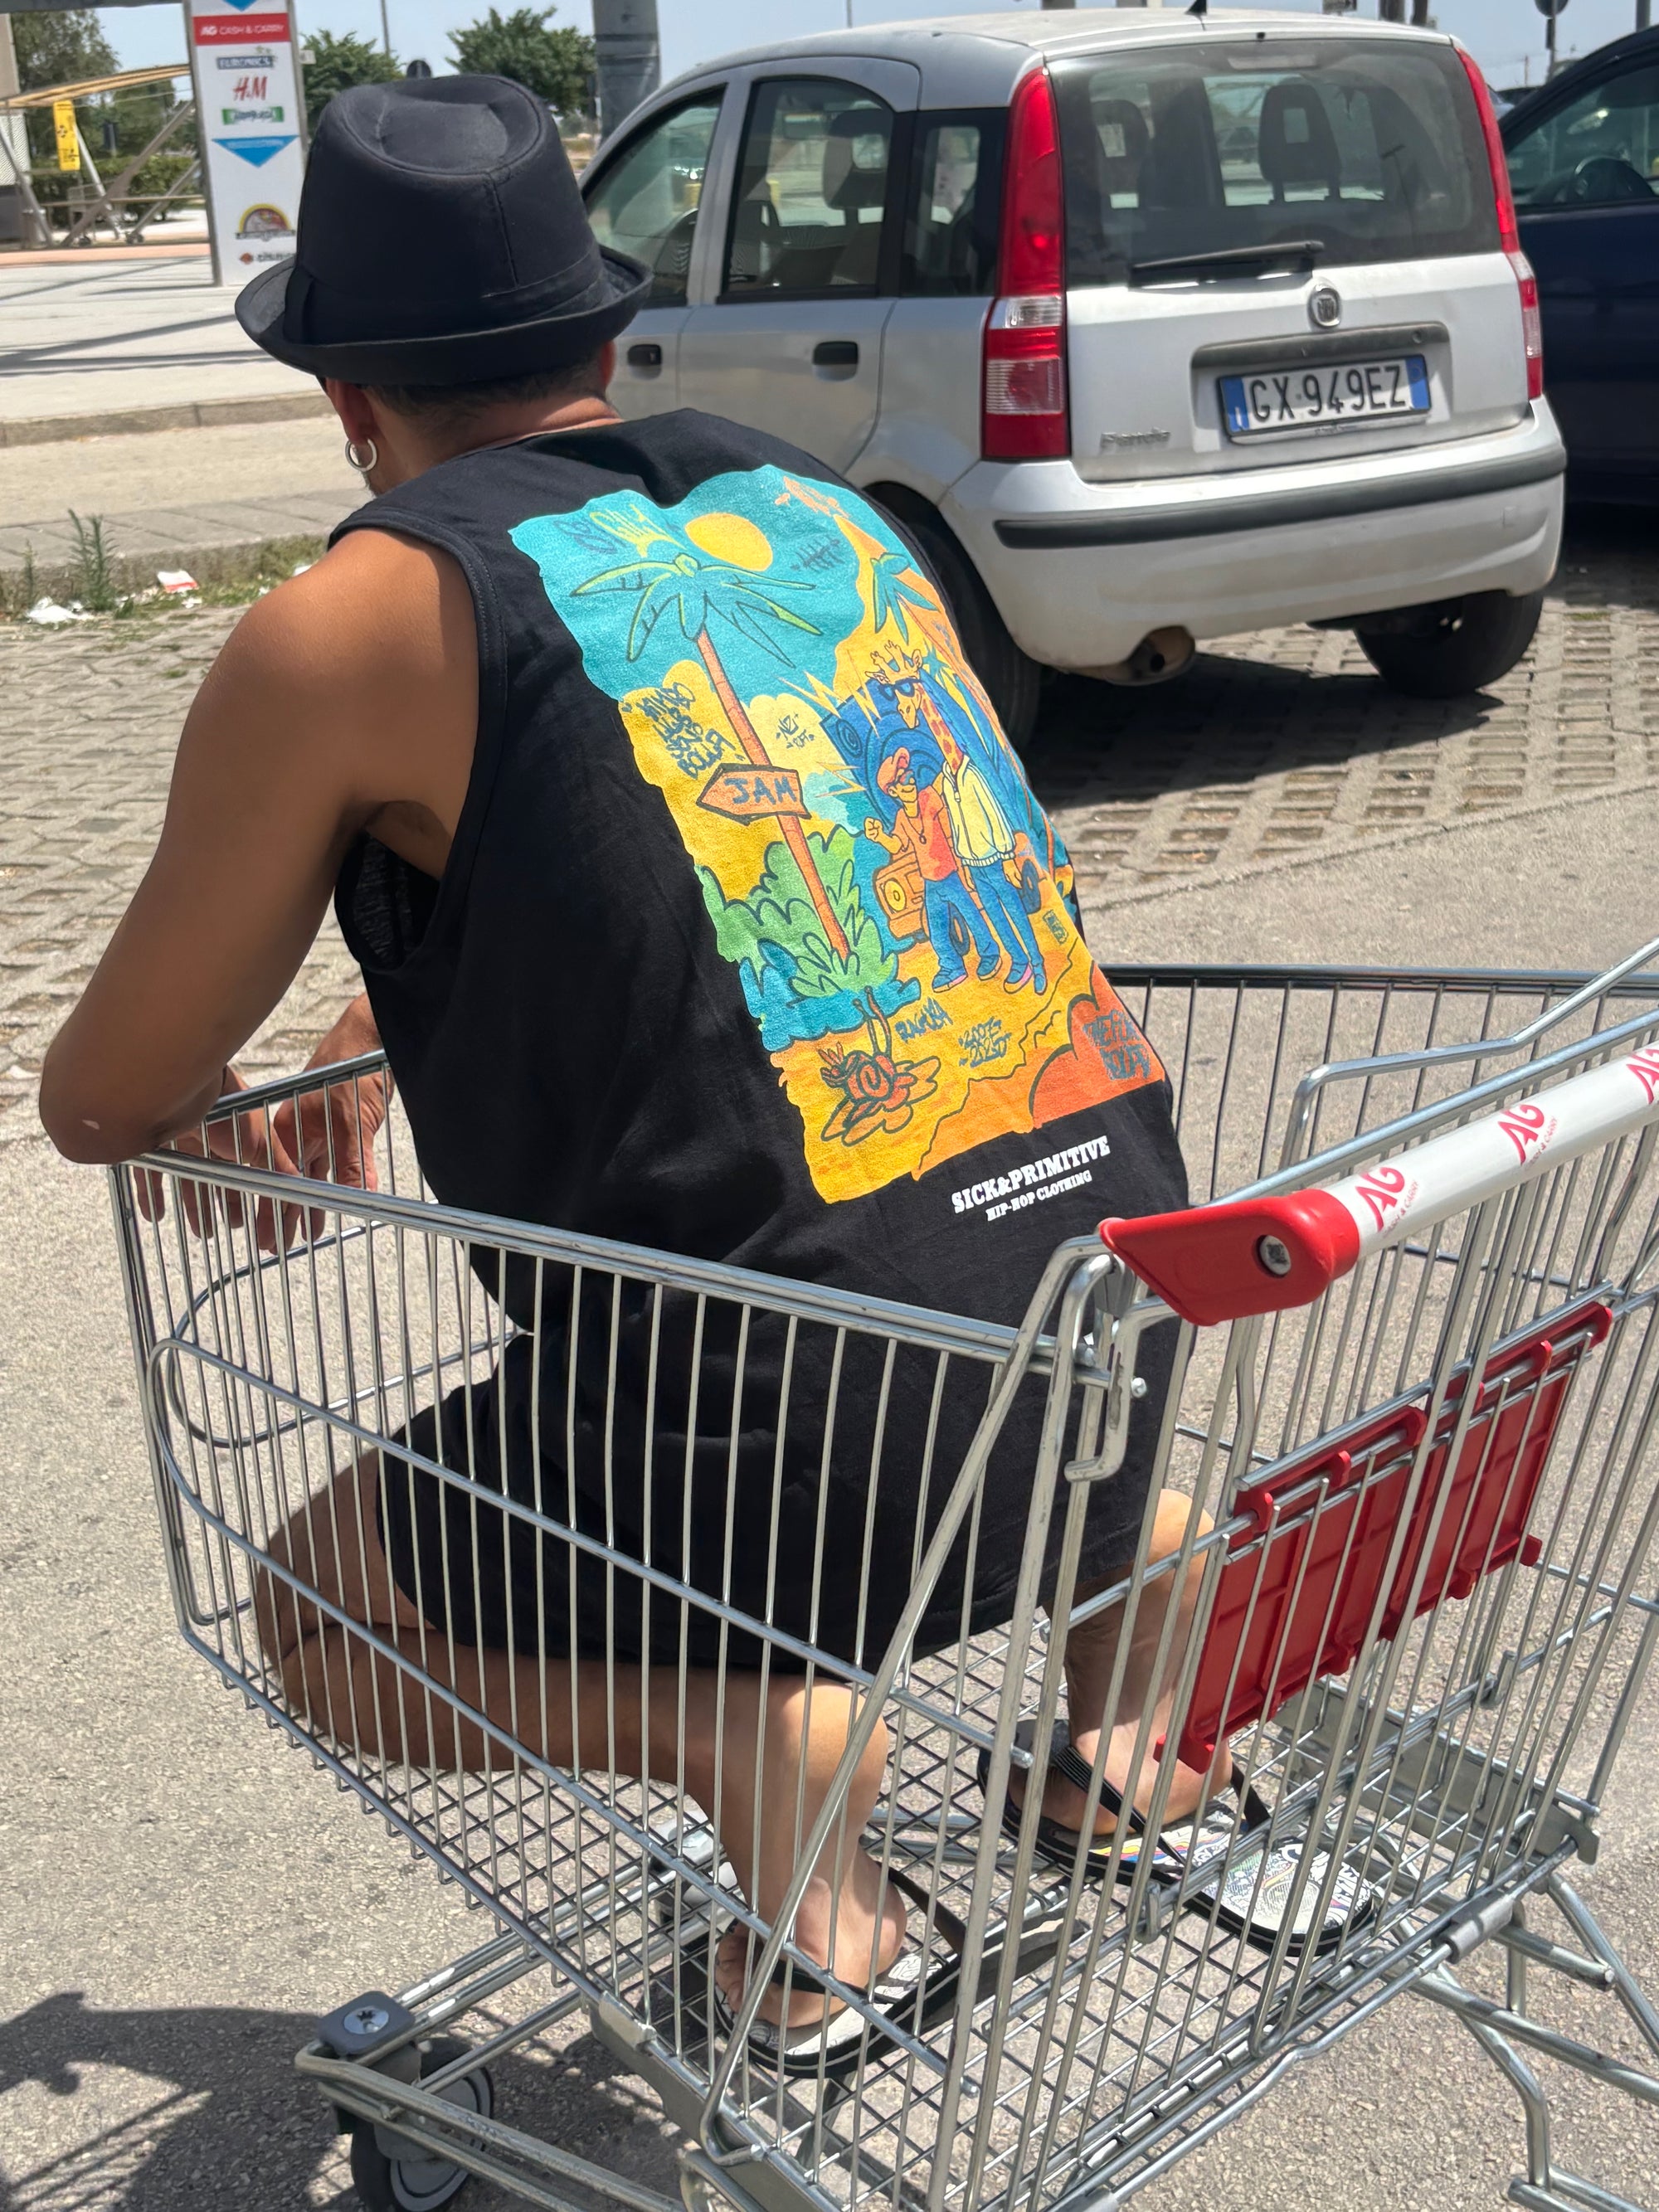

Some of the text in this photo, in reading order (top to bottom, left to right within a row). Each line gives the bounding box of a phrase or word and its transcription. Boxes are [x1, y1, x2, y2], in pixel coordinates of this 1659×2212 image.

[232, 76, 268, 101] H&M
[724, 775, 797, 805] JAM
[1497, 1104, 1545, 1166] AG
[951, 1135, 1111, 1213] SICK&PRIMITIVE
[985, 1169, 1093, 1222] HIP-HOP CLOTHING
[1355, 1167, 1405, 1232] AG
